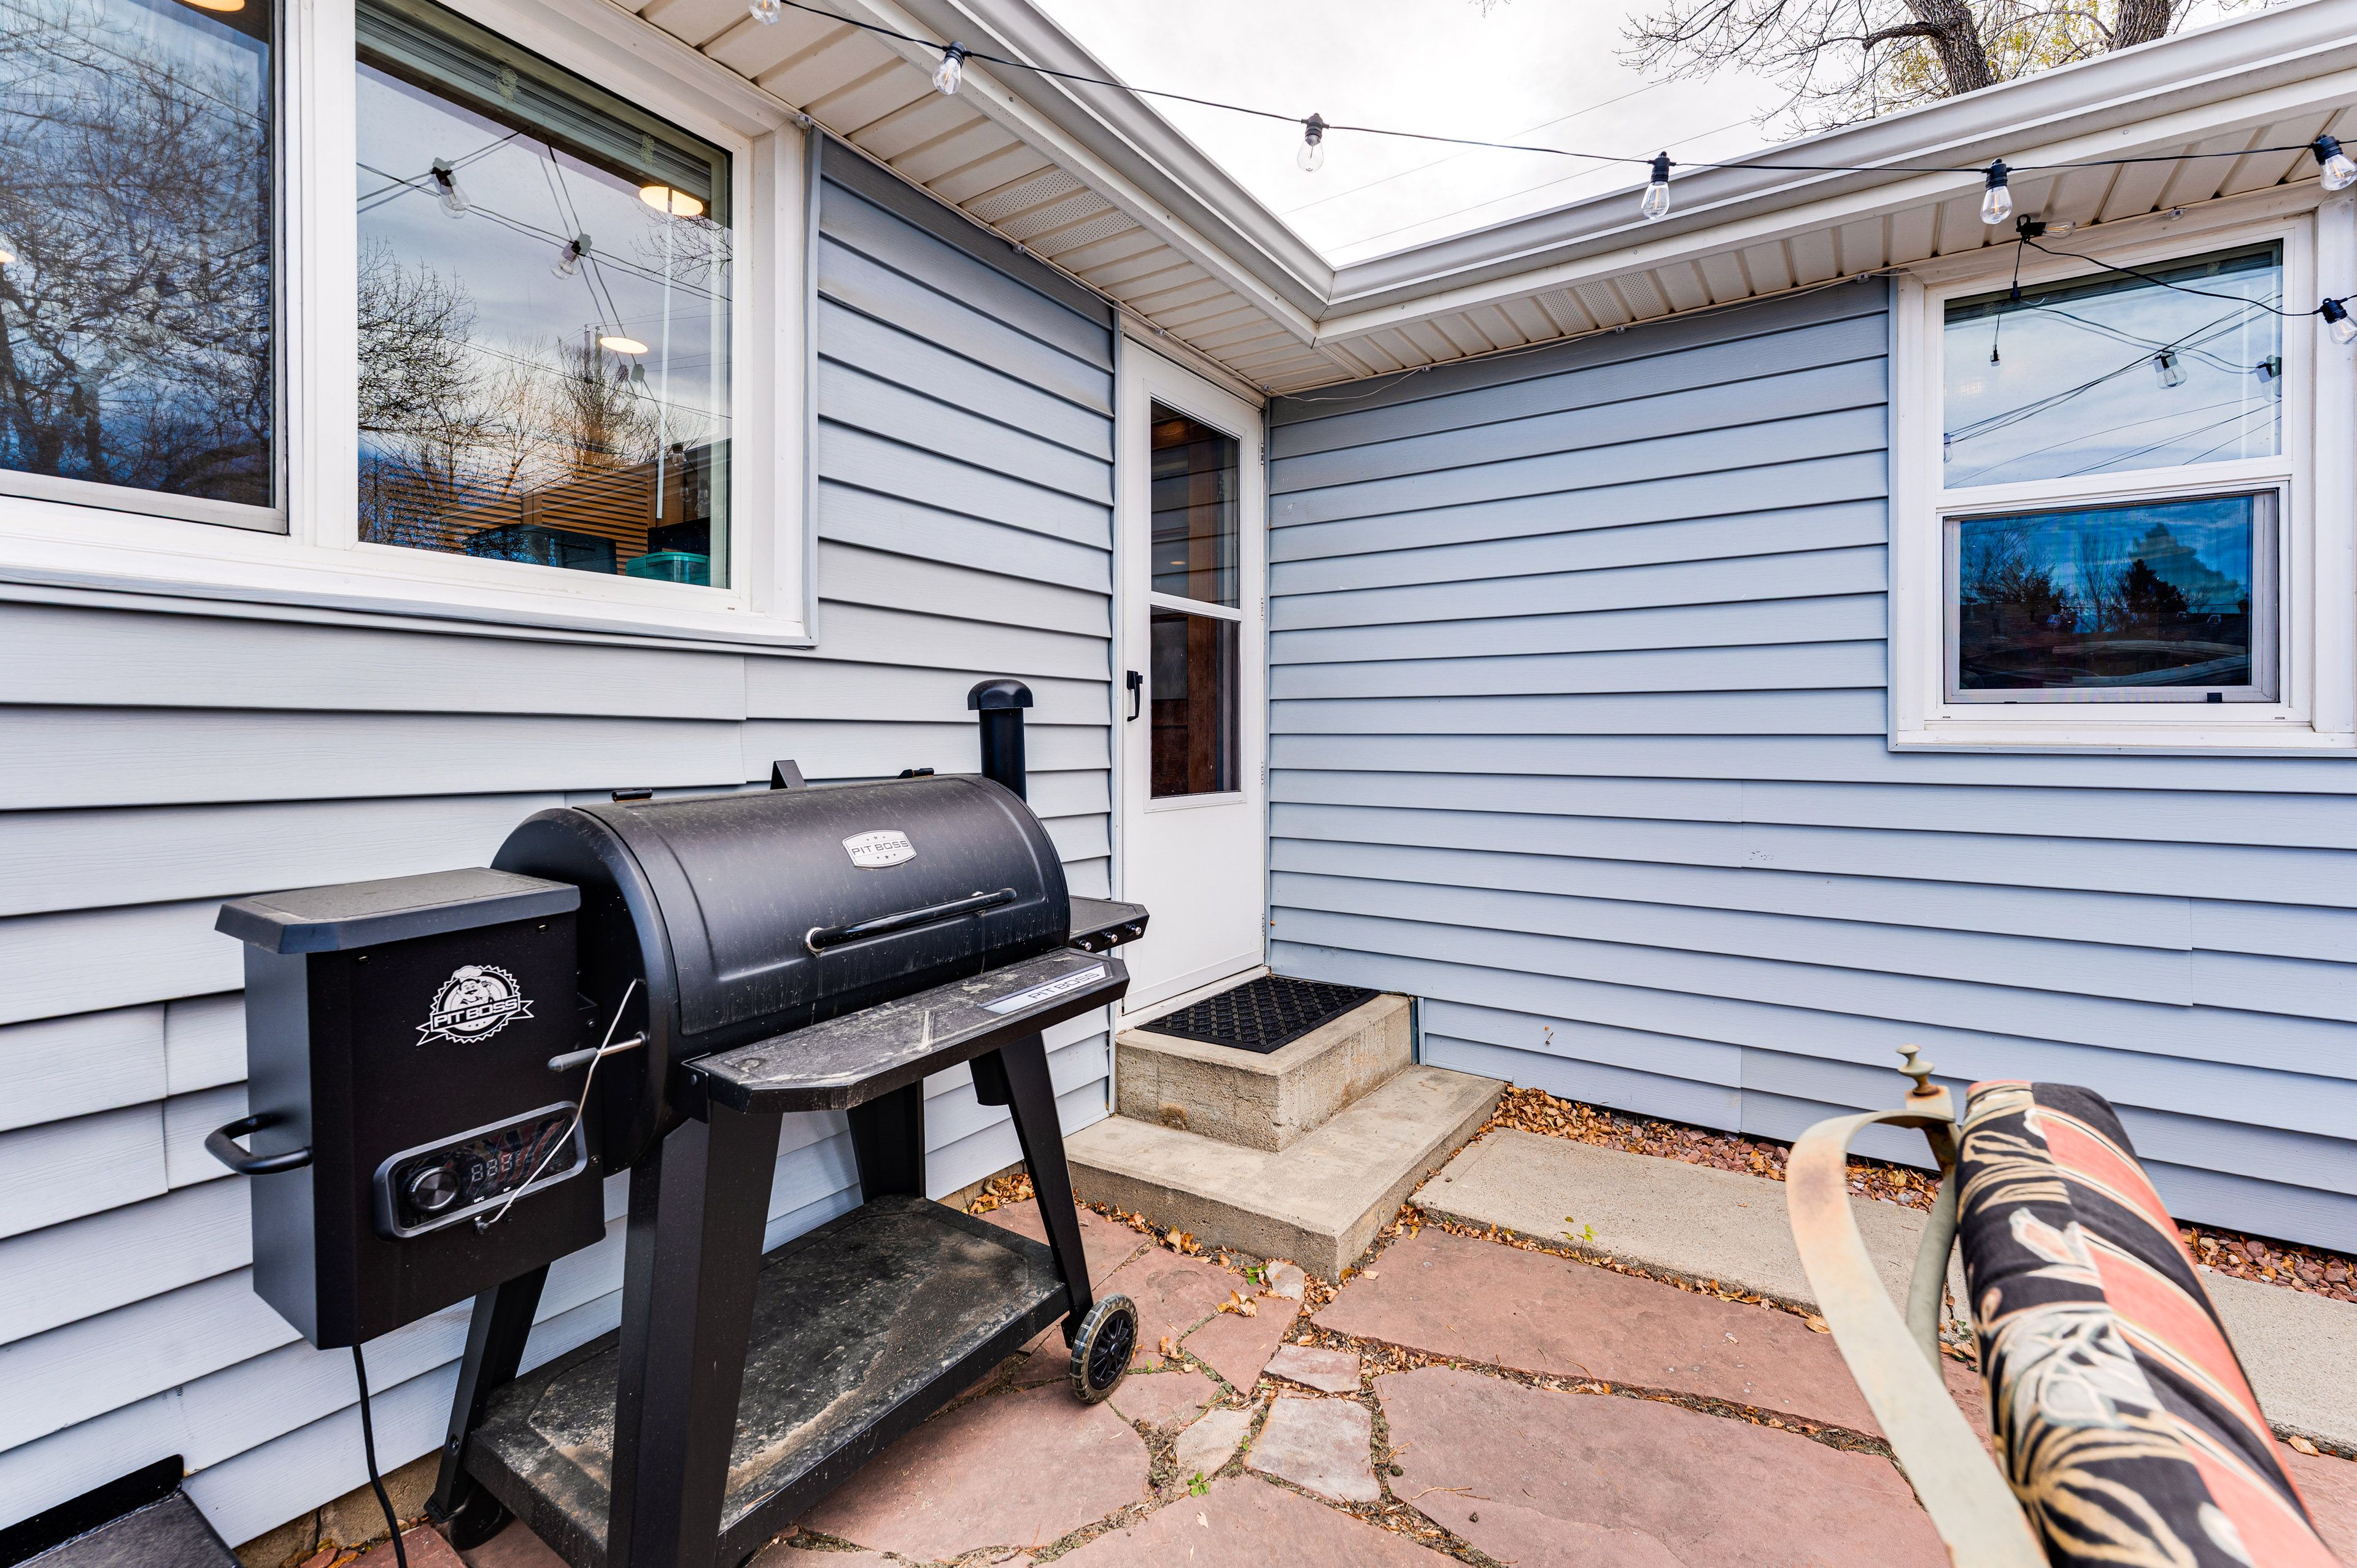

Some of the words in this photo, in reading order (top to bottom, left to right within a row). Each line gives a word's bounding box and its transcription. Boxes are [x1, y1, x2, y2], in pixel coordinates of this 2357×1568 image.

[851, 846, 872, 855] PIT
[875, 841, 908, 851] BOSS
[1028, 987, 1055, 999] PIT
[1054, 973, 1099, 989] BOSS
[434, 1011, 464, 1028] PIT
[466, 998, 518, 1020] BOSS
